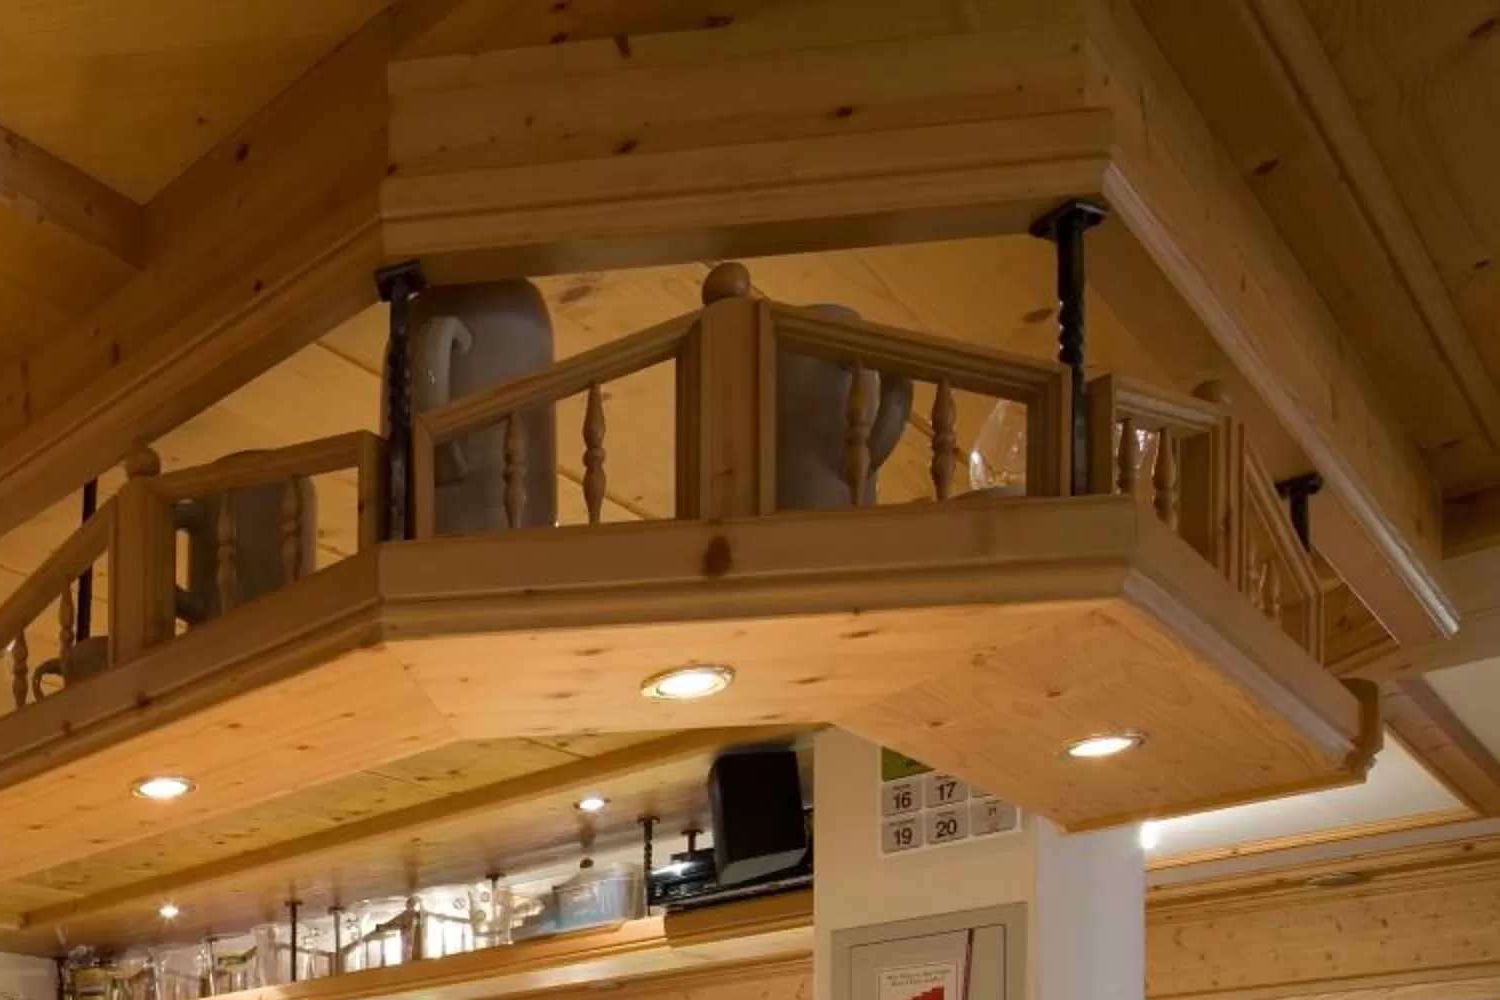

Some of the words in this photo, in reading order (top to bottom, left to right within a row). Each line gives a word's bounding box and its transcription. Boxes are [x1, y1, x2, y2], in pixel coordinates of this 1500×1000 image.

[892, 791, 912, 809] 16
[936, 781, 957, 801] 17
[893, 827, 913, 845] 19
[935, 818, 958, 838] 20
